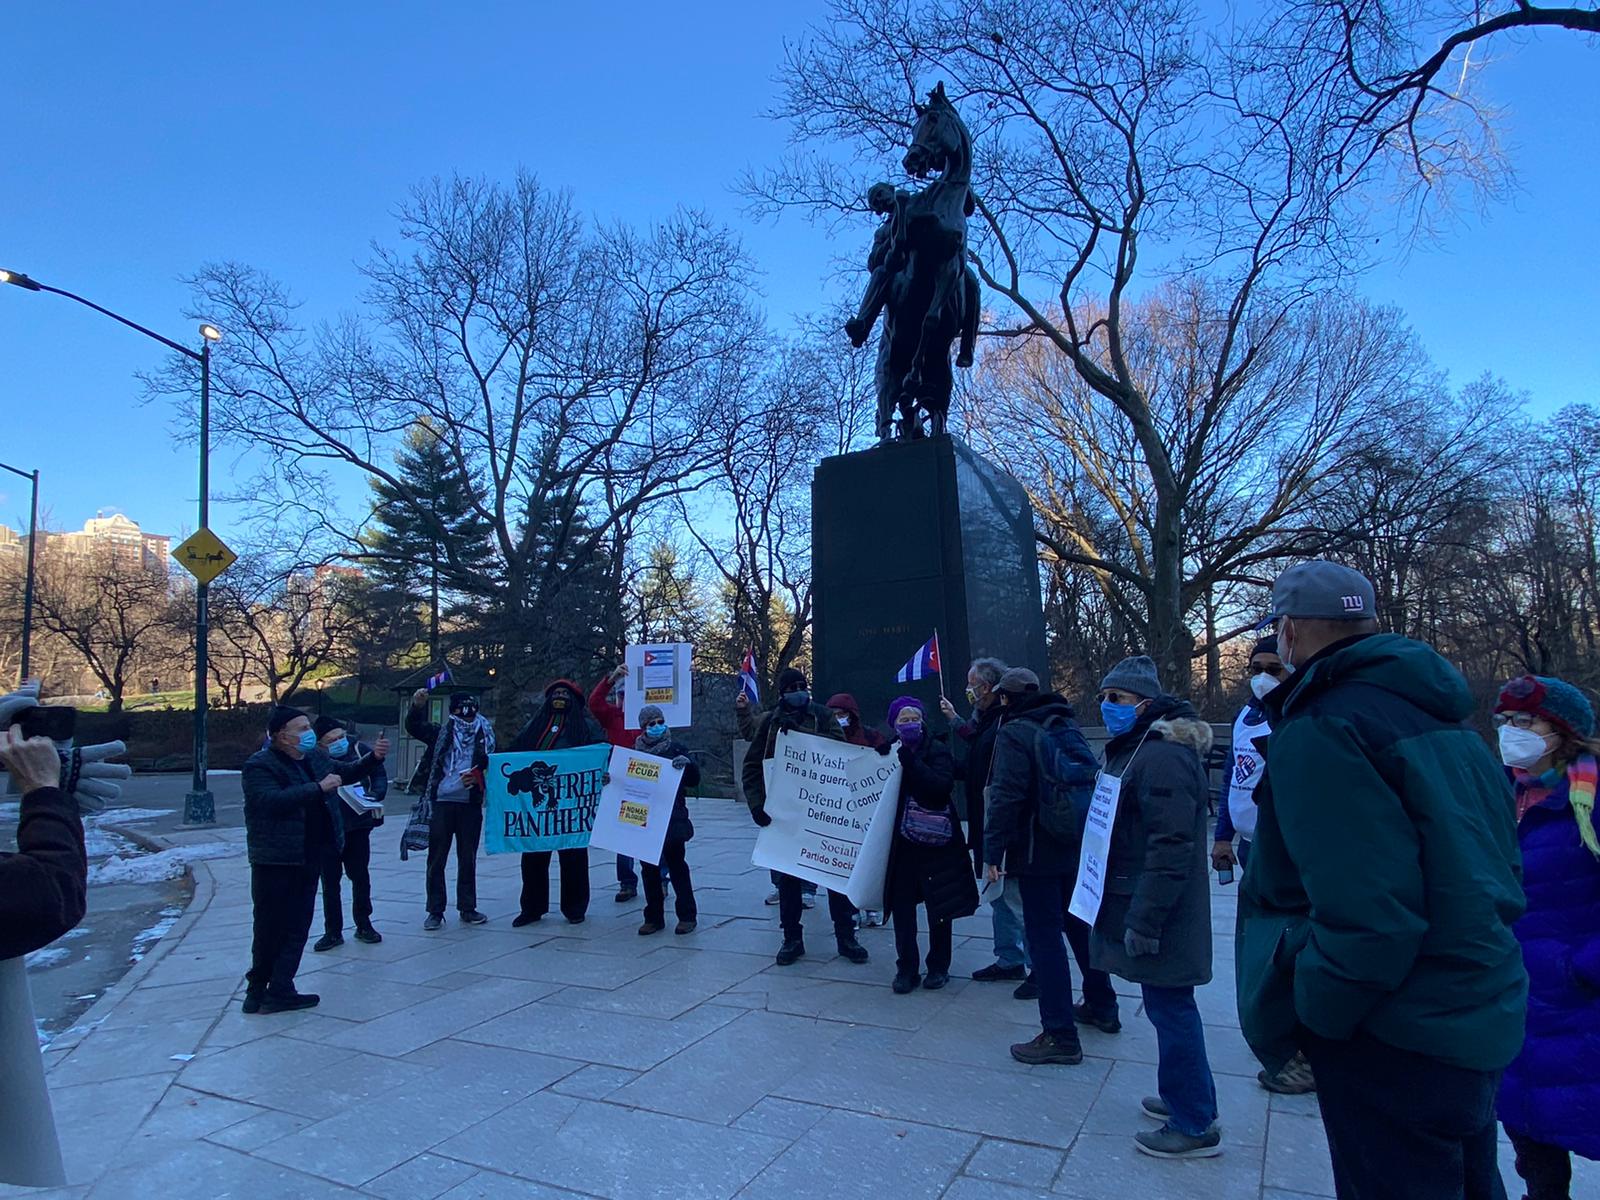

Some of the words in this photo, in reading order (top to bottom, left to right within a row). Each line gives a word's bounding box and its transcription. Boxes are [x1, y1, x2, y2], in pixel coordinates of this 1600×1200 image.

[784, 745, 806, 762] End
[811, 751, 847, 771] Wash
[785, 763, 800, 775] Fin
[801, 768, 807, 777] a
[809, 768, 818, 781] la
[556, 768, 602, 800] FREE
[860, 774, 876, 789] on
[577, 792, 601, 808] THE
[798, 787, 842, 810] Defend
[857, 790, 883, 807] contr
[807, 808, 849, 828] Defiende
[800, 847, 830, 865] Partido
[820, 839, 858, 858] Sociali
